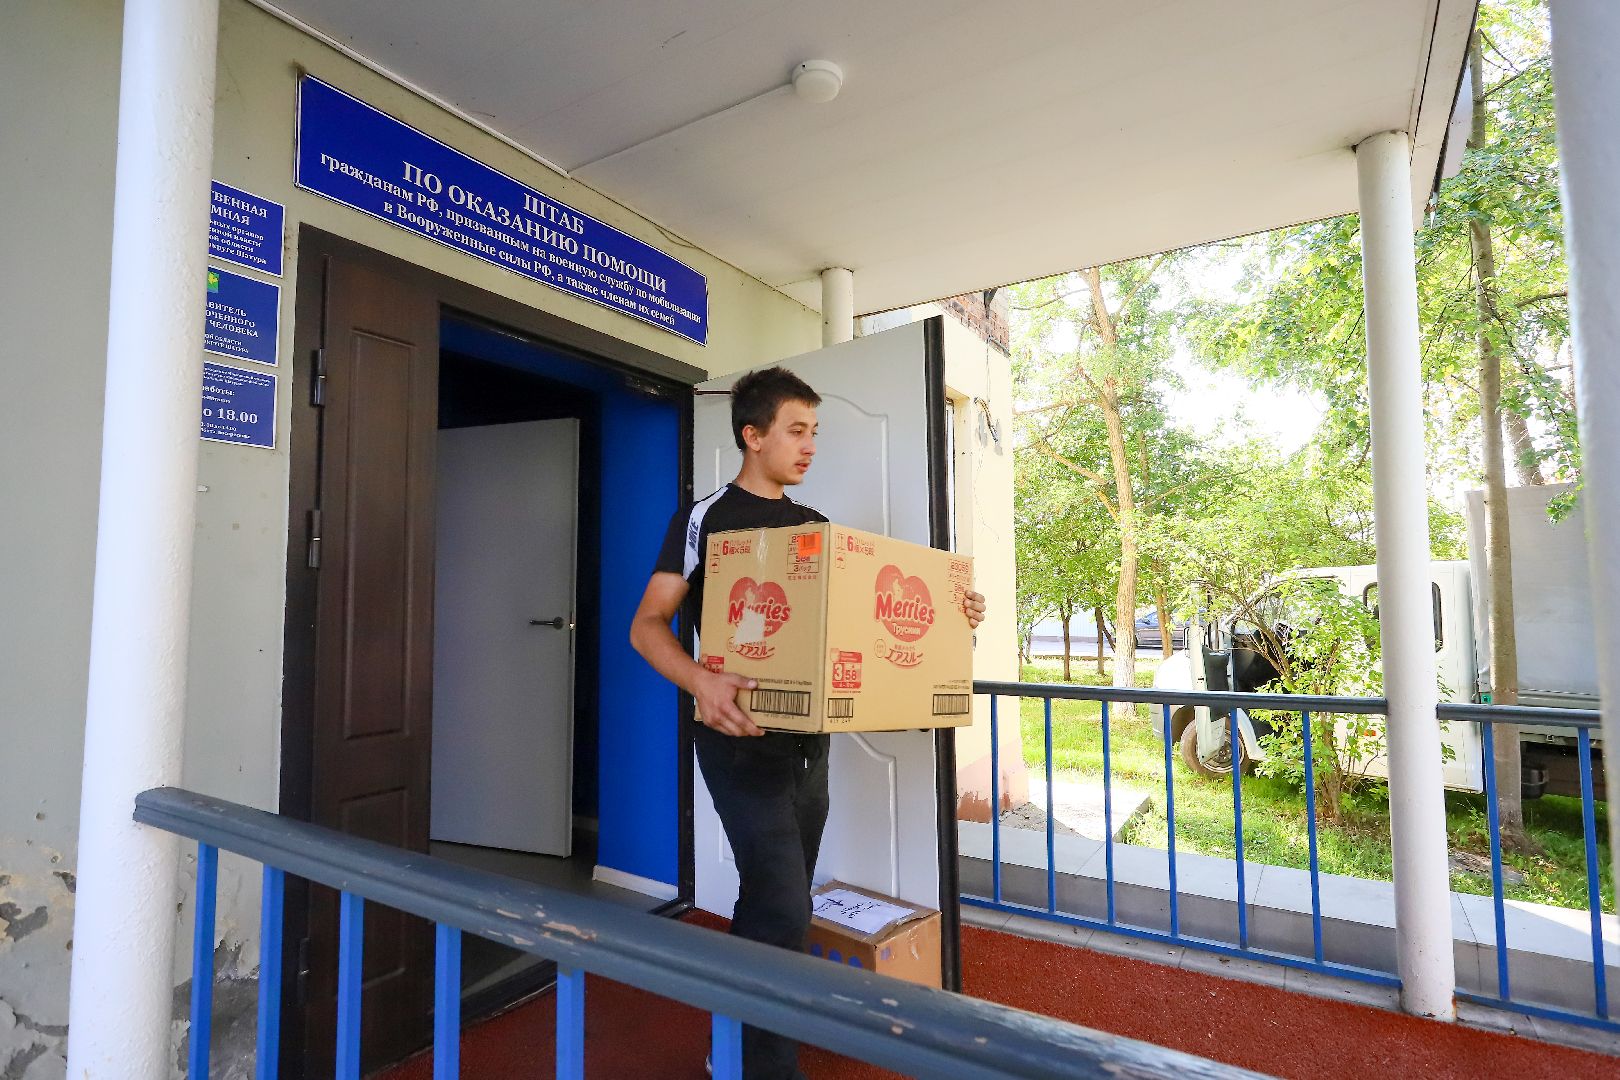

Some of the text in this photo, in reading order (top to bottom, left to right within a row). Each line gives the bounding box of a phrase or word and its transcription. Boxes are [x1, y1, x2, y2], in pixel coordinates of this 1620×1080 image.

[211, 190, 267, 218] ВЕННАЯ
[211, 204, 250, 226] МНАЯ
[523, 192, 584, 235] ШТАБ
[320, 152, 702, 324] гражданам РФ, призванным на военную службу по мобилизации
[402, 160, 667, 294] ПО ОКАЗАНИЮ ПОМОЩИ
[383, 201, 675, 326] в Вооруженные силы РФ, а также членам их семей
[205, 309, 255, 328] ОЧЕННОГО
[206, 301, 247, 317] ВИТЕЛЬ
[209, 319, 259, 338] ЧЕЛОВЕКА
[217, 408, 258, 424] 18.00
[722, 540, 730, 556] 6
[847, 536, 854, 552] 6
[728, 599, 792, 625] Mrries
[876, 593, 935, 625] Merries
[834, 662, 857, 681] 3 58
